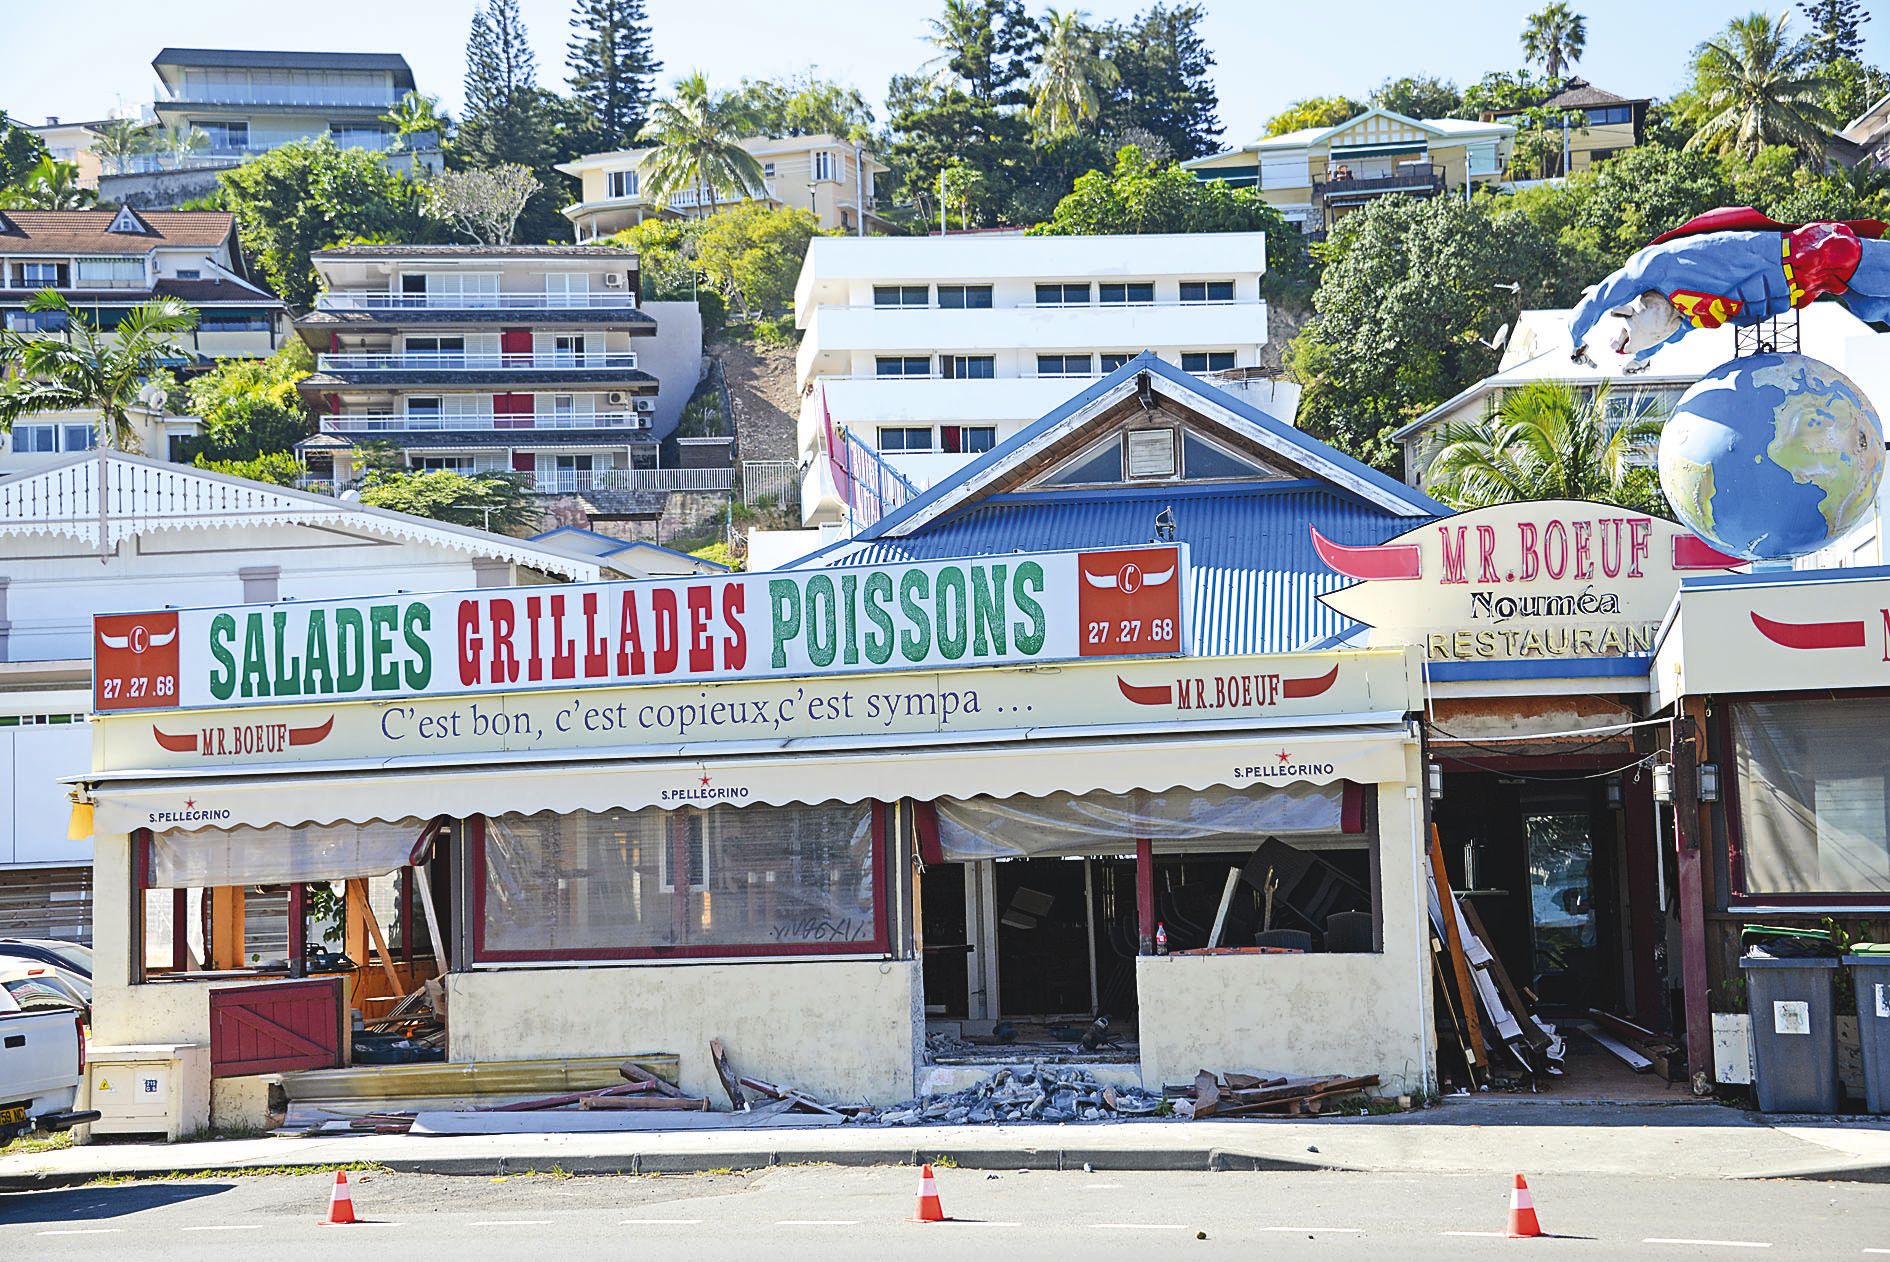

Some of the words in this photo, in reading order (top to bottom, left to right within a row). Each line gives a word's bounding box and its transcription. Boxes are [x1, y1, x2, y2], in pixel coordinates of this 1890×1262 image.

[1439, 518, 1652, 584] MR.BOEUF
[1470, 586, 1620, 624] Nouméa
[209, 602, 432, 700] SALADES
[457, 583, 747, 687] GRILLADES
[768, 561, 1046, 669] POISSONS
[1088, 621, 1109, 643] 27
[1426, 621, 1661, 658] RESTAURAN
[103, 678, 121, 699] 27
[1176, 673, 1280, 710] MR.BOEUF
[381, 707, 461, 740] C'est
[470, 703, 543, 740] bon,
[555, 699, 627, 733] c'est
[867, 689, 981, 726] sympa
[201, 724, 287, 757] MR.BOEUF
[1233, 763, 1335, 779] S.PELLEGRINO
[661, 787, 749, 801] S.PELLEGRINO
[149, 809, 231, 824] S.PELLEGRINO
